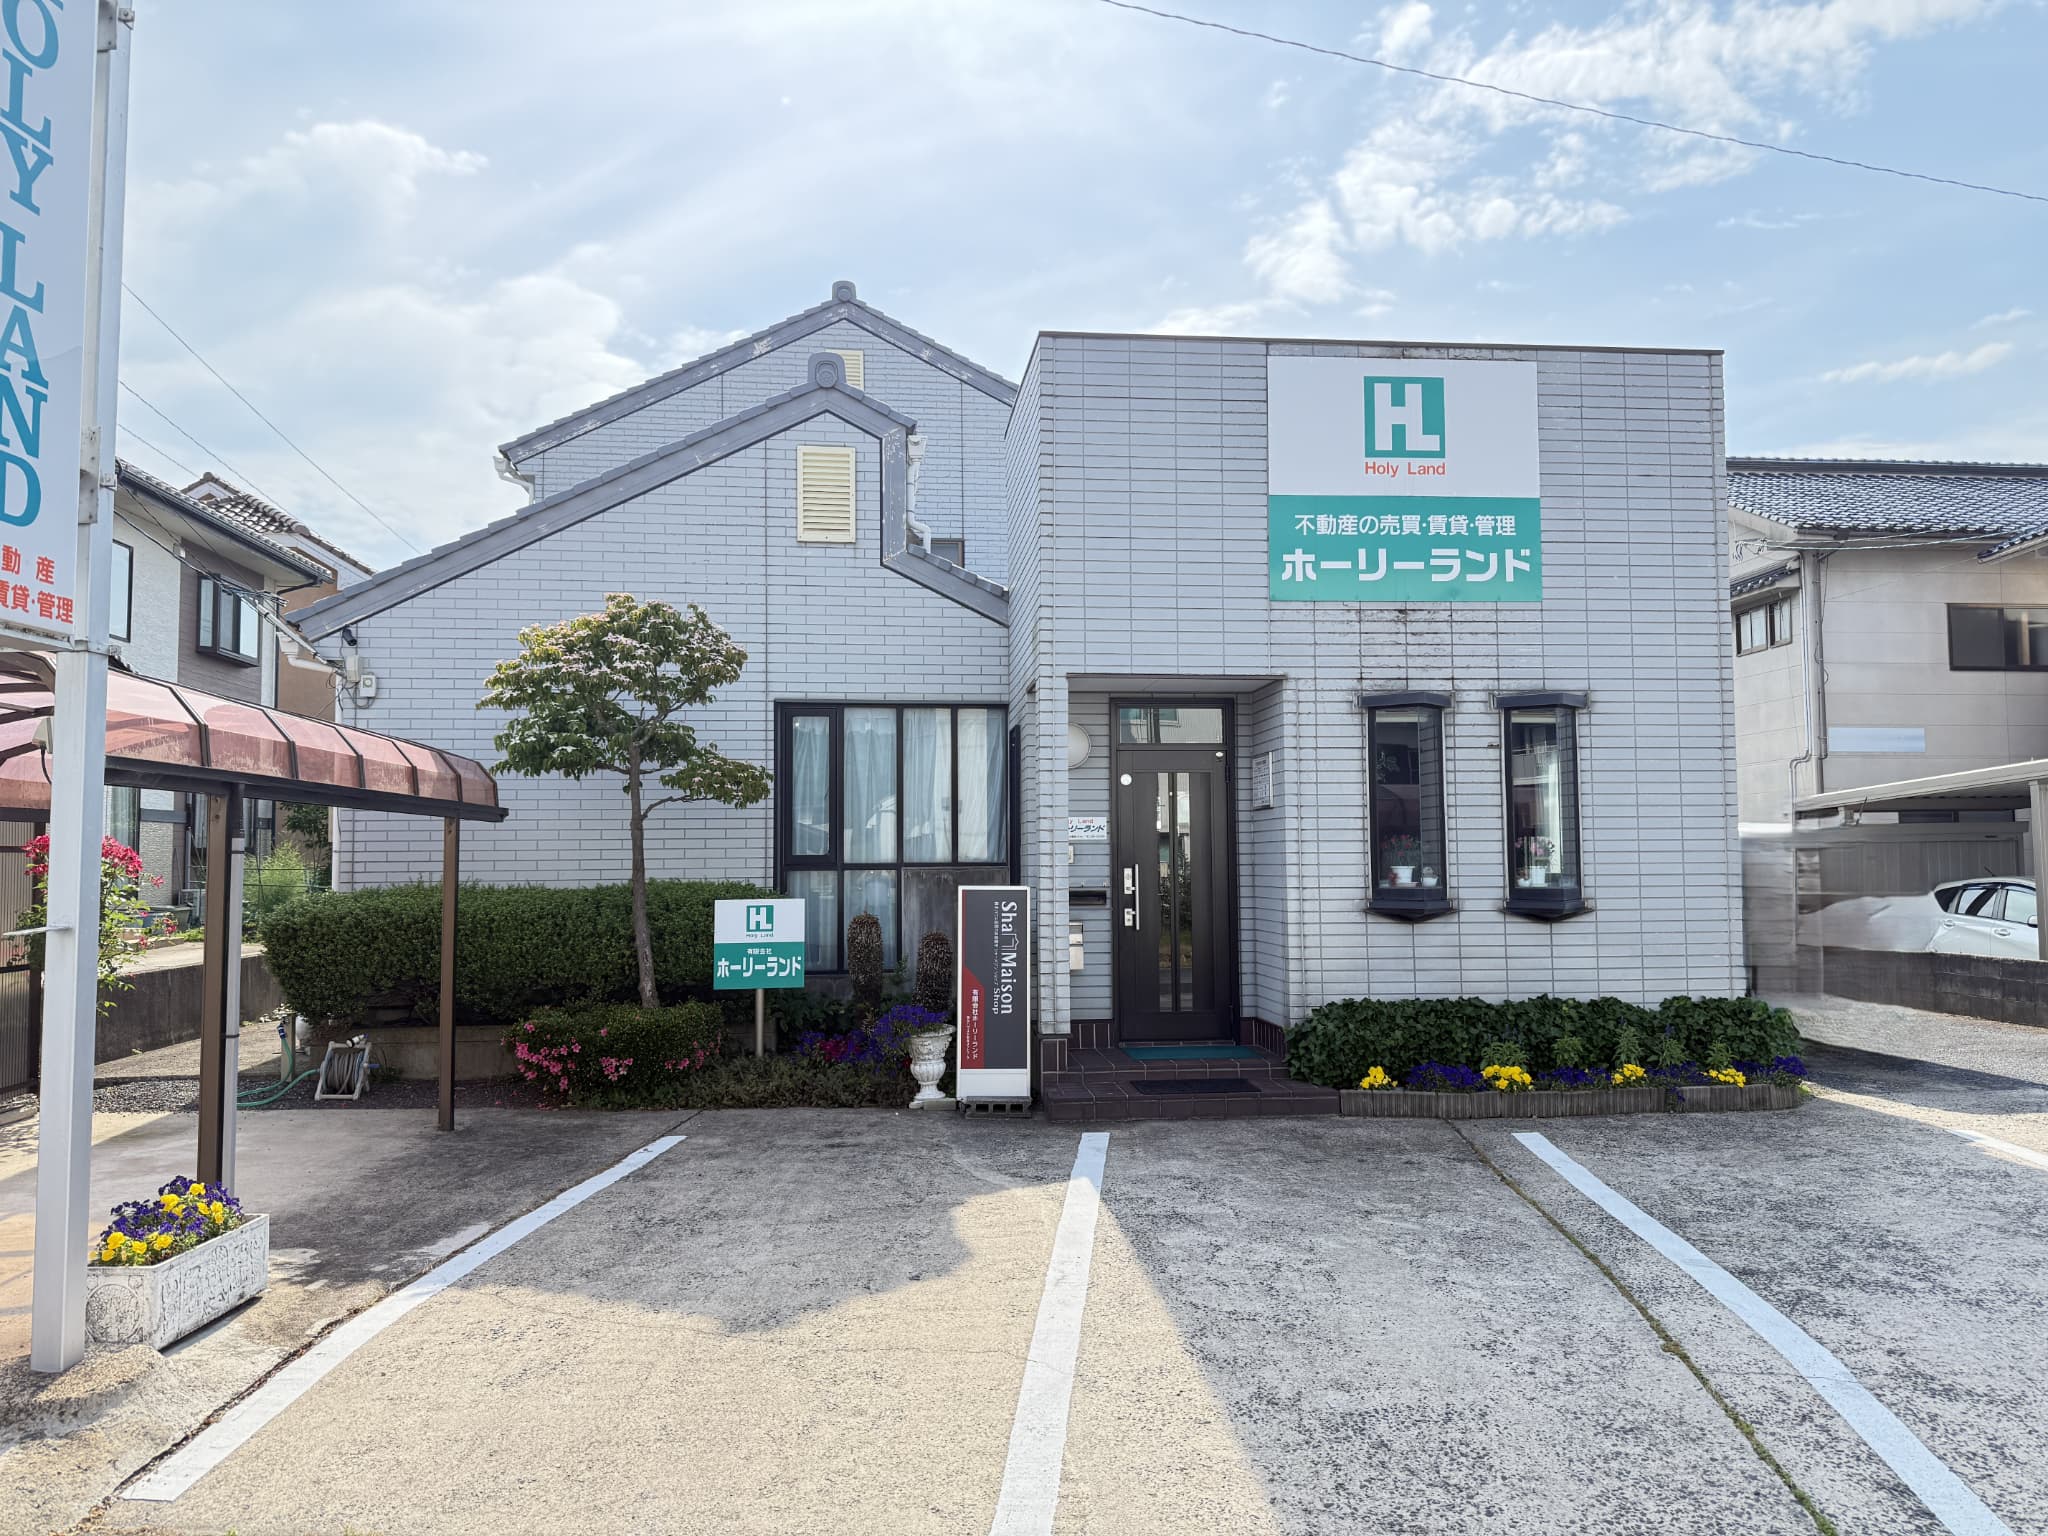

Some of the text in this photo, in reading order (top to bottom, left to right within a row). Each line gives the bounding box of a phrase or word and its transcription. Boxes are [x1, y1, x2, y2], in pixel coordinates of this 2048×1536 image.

[0, 0, 63, 527] OLY LAND
[1364, 461, 1446, 478] Holy Land
[1281, 548, 1531, 582] ホーリーランド
[717, 956, 802, 978] ホーリーランド
[1001, 901, 1018, 1014] Sha Maison
